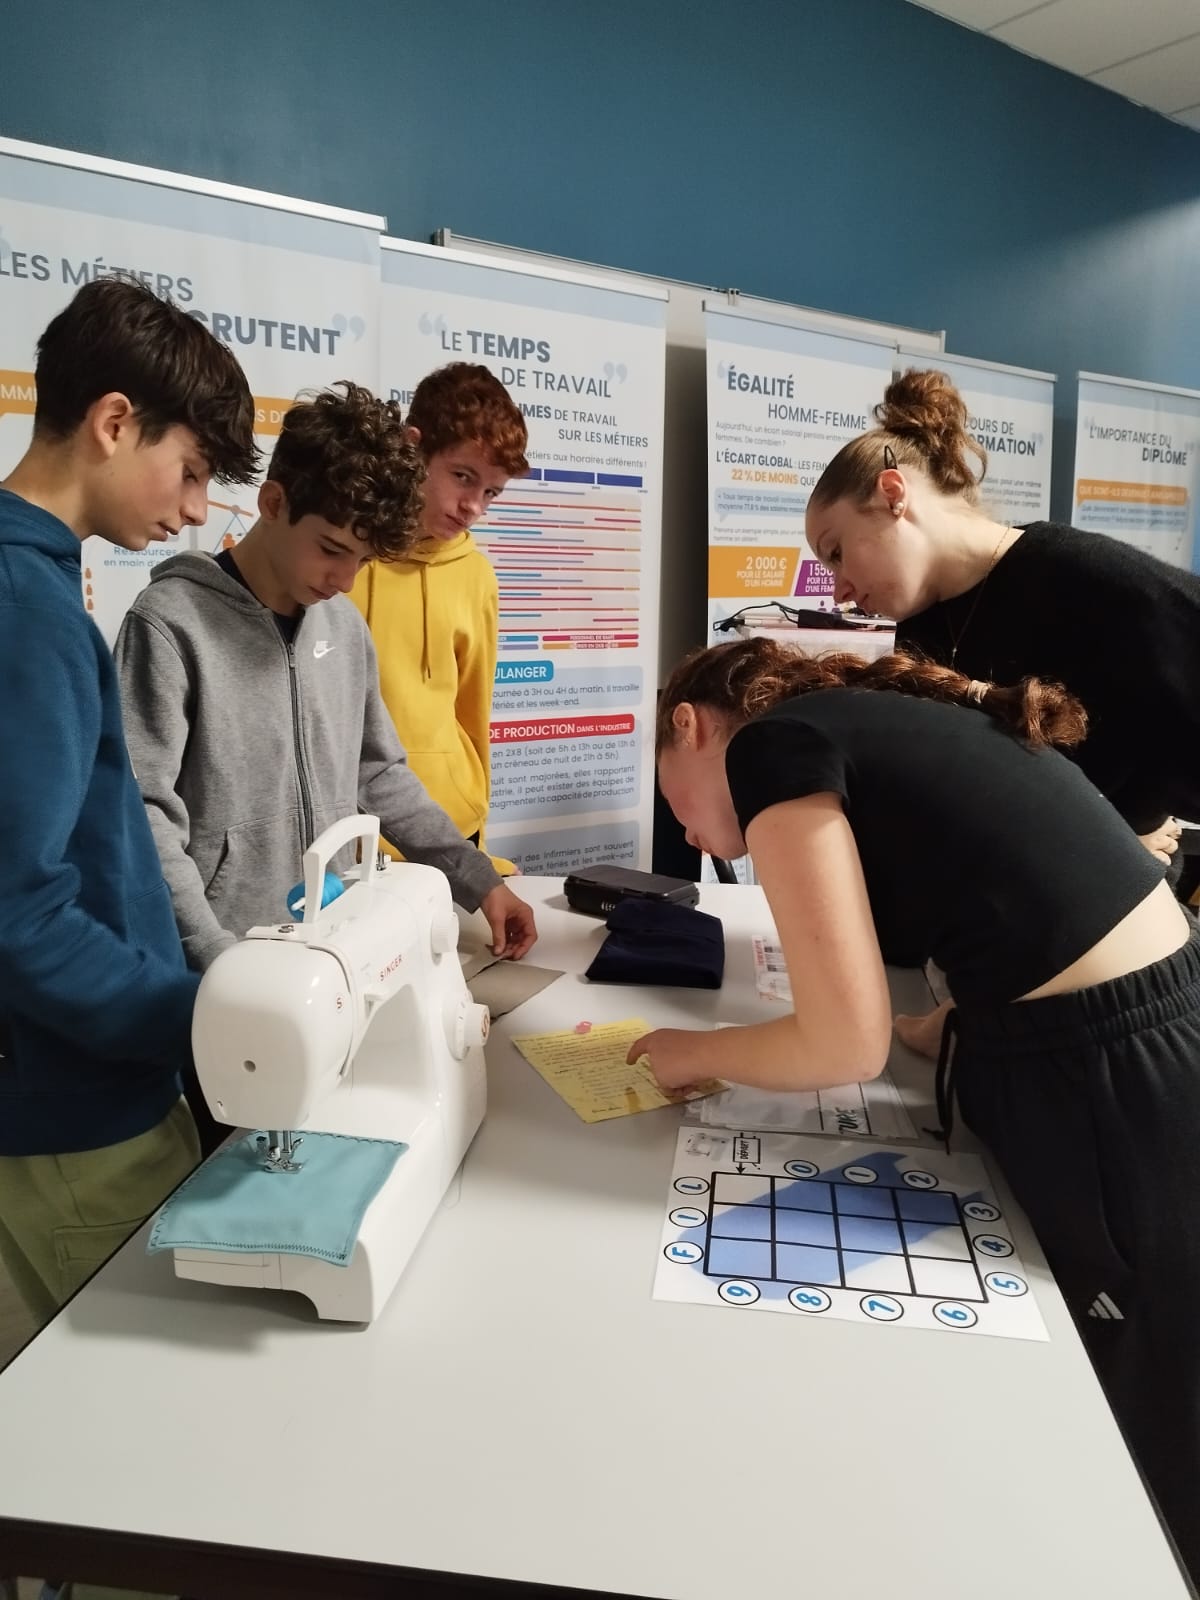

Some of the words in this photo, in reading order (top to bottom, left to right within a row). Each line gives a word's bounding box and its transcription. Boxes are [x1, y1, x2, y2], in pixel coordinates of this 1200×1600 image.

[0, 251, 51, 282] LES
[441, 330, 463, 352] LE
[466, 329, 551, 364] TEMPS
[501, 365, 527, 388] DE
[532, 369, 612, 399] TRAVAIL
[727, 364, 795, 399] ÉGALITÉ
[554, 408, 569, 422] DE
[571, 410, 618, 427] TRAVAIL
[767, 402, 868, 431] HOMME-FEMME
[1001, 421, 1015, 436] DE
[1089, 425, 1158, 446] L'IMPORTANCE
[558, 428, 583, 442] SUR
[585, 431, 603, 444] LES
[604, 432, 649, 449] MÉTIERS
[552, 453, 568, 462] aux
[569, 453, 604, 465] horaires
[716, 448, 757, 465] L'ÉCART
[757, 454, 793, 469] GLOBAL
[731, 468, 743, 481] 22
[755, 471, 768, 483] DE
[768, 472, 799, 485] MOINS
[800, 476, 816, 487] QUE
[746, 555, 754, 571] 2
[754, 556, 778, 571] 000
[778, 557, 788, 570] €
[503, 723, 575, 739] PRODUCTION
[907, 1172, 931, 1186] 2
[969, 1206, 994, 1218] 3
[981, 1239, 1007, 1252] 4
[726, 1284, 752, 1298] 9
[992, 1277, 1020, 1291] 5
[795, 1291, 823, 1307] 8
[868, 1299, 897, 1313] 7
[940, 1308, 970, 1322] 6
